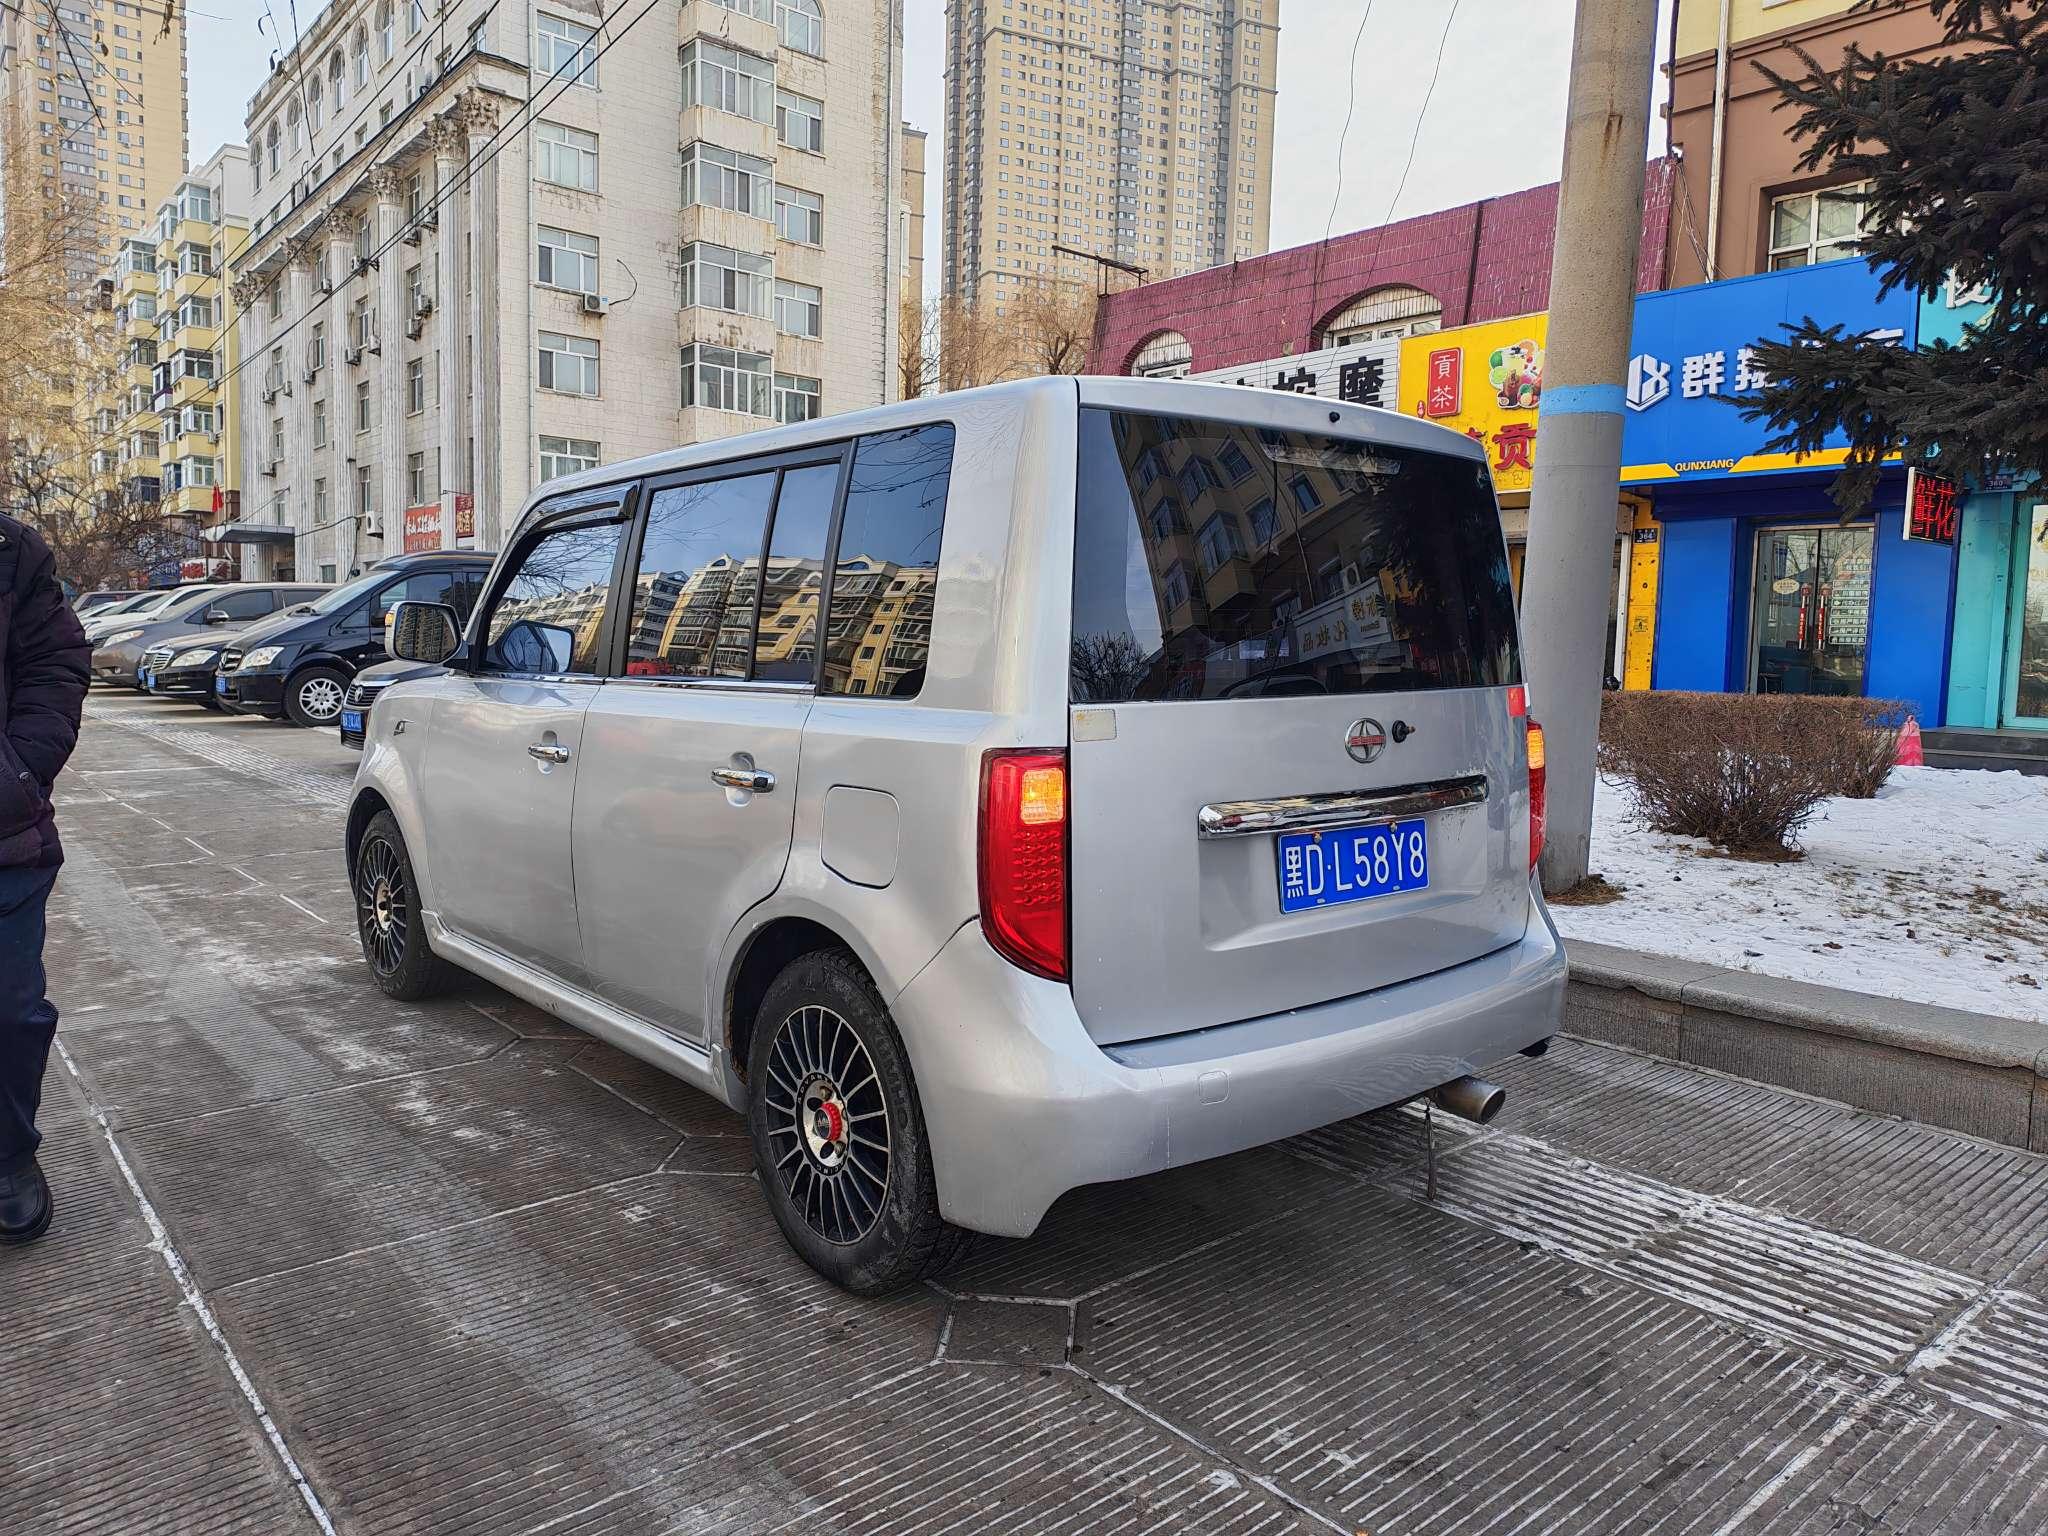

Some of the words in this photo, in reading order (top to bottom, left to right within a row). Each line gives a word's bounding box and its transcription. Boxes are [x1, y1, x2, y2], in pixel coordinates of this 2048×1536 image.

[1431, 354, 1456, 409] 貢茶
[1466, 423, 1537, 471] 贡
[1674, 458, 1735, 473] QUNXIANG
